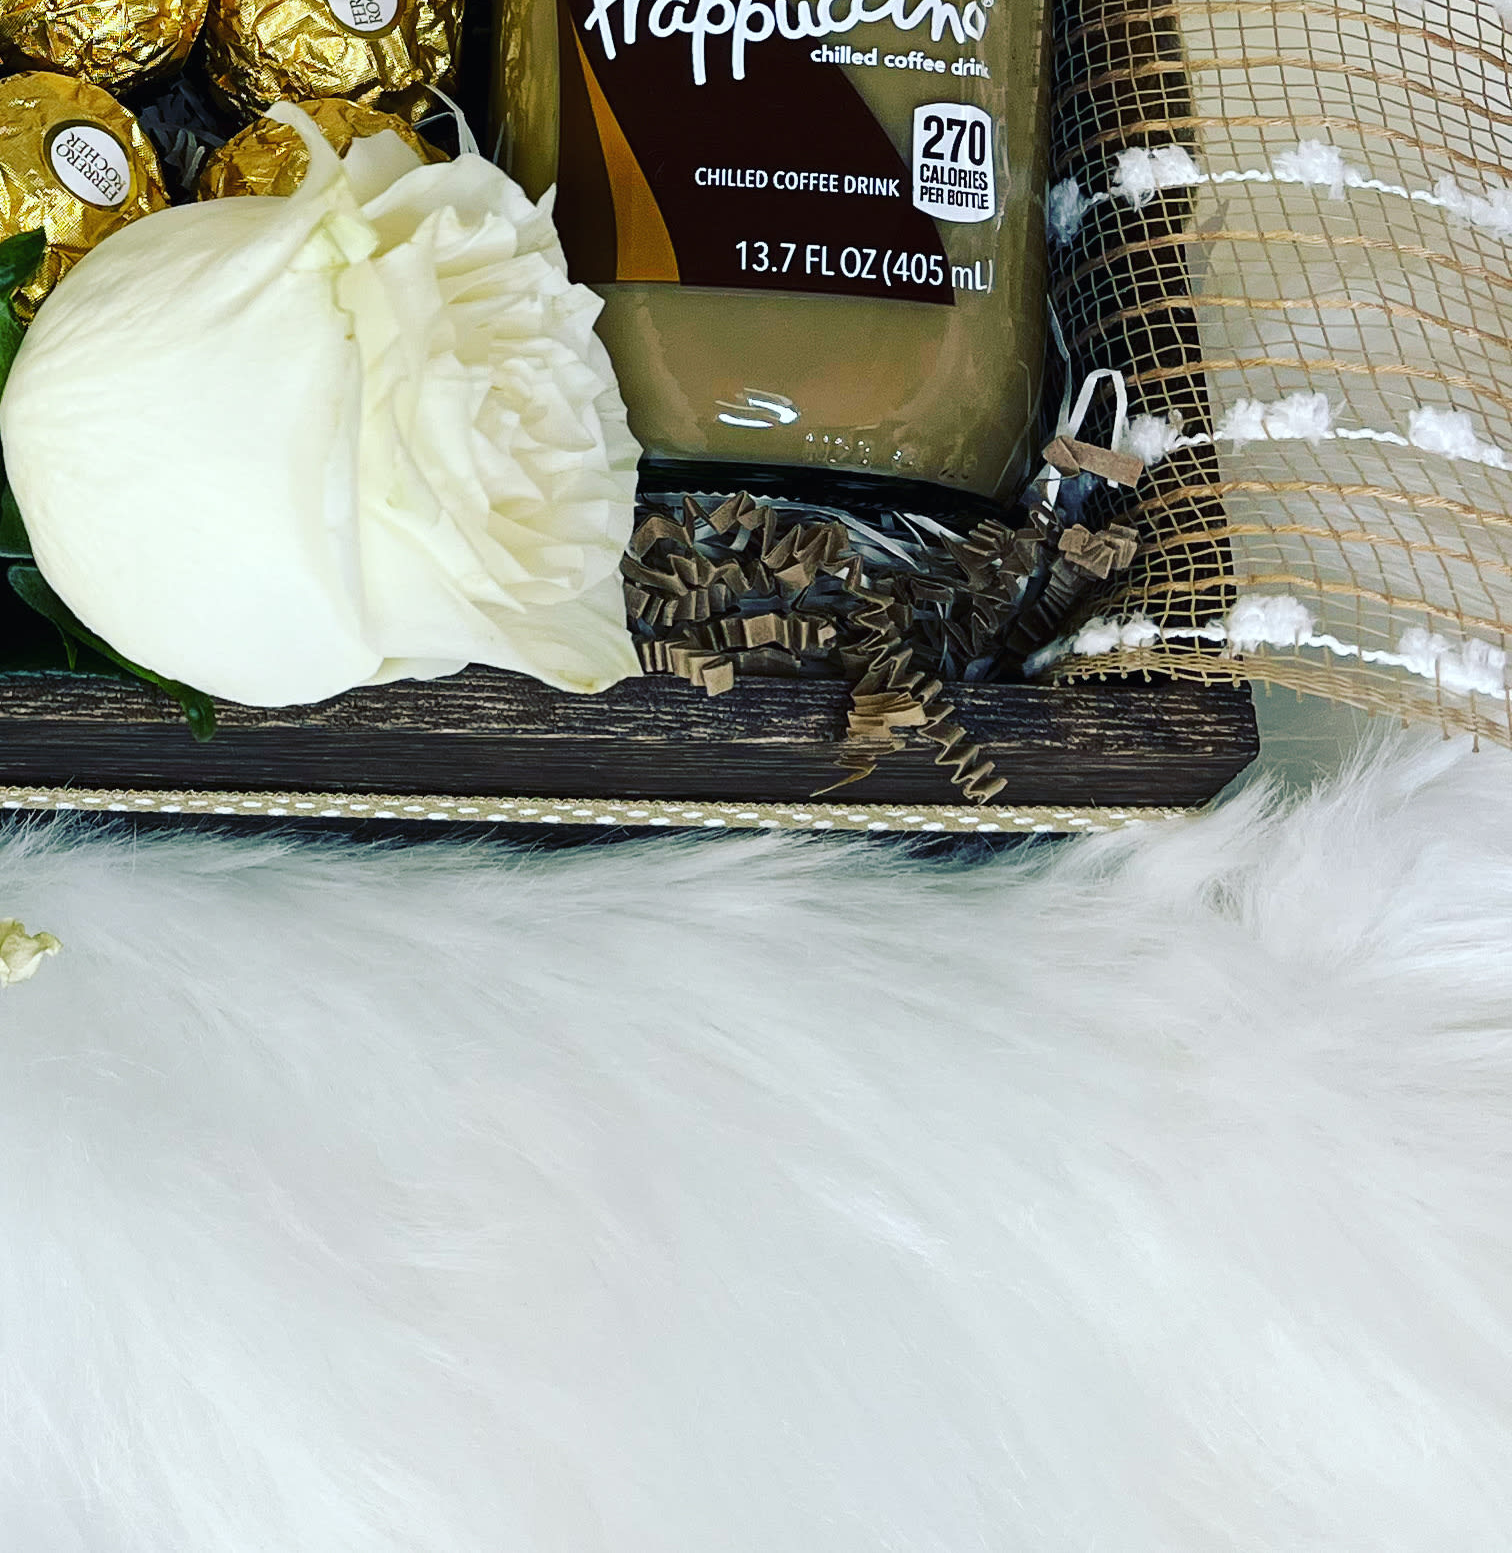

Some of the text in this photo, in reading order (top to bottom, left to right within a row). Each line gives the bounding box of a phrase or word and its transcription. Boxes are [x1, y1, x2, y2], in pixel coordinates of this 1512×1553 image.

[810, 44, 878, 66] chilled
[883, 51, 946, 73] coffee
[922, 115, 985, 166] 270
[55, 143, 118, 202] FERRERO
[66, 131, 126, 192] ROCHER
[919, 163, 988, 191] CALORIES
[694, 167, 900, 197] CHILLED COFFEE DRINK
[919, 185, 990, 210] PER BOTTLE
[735, 241, 796, 273] 13.7
[805, 245, 835, 276] FL
[840, 247, 877, 279] OZ
[882, 250, 943, 286] (405
